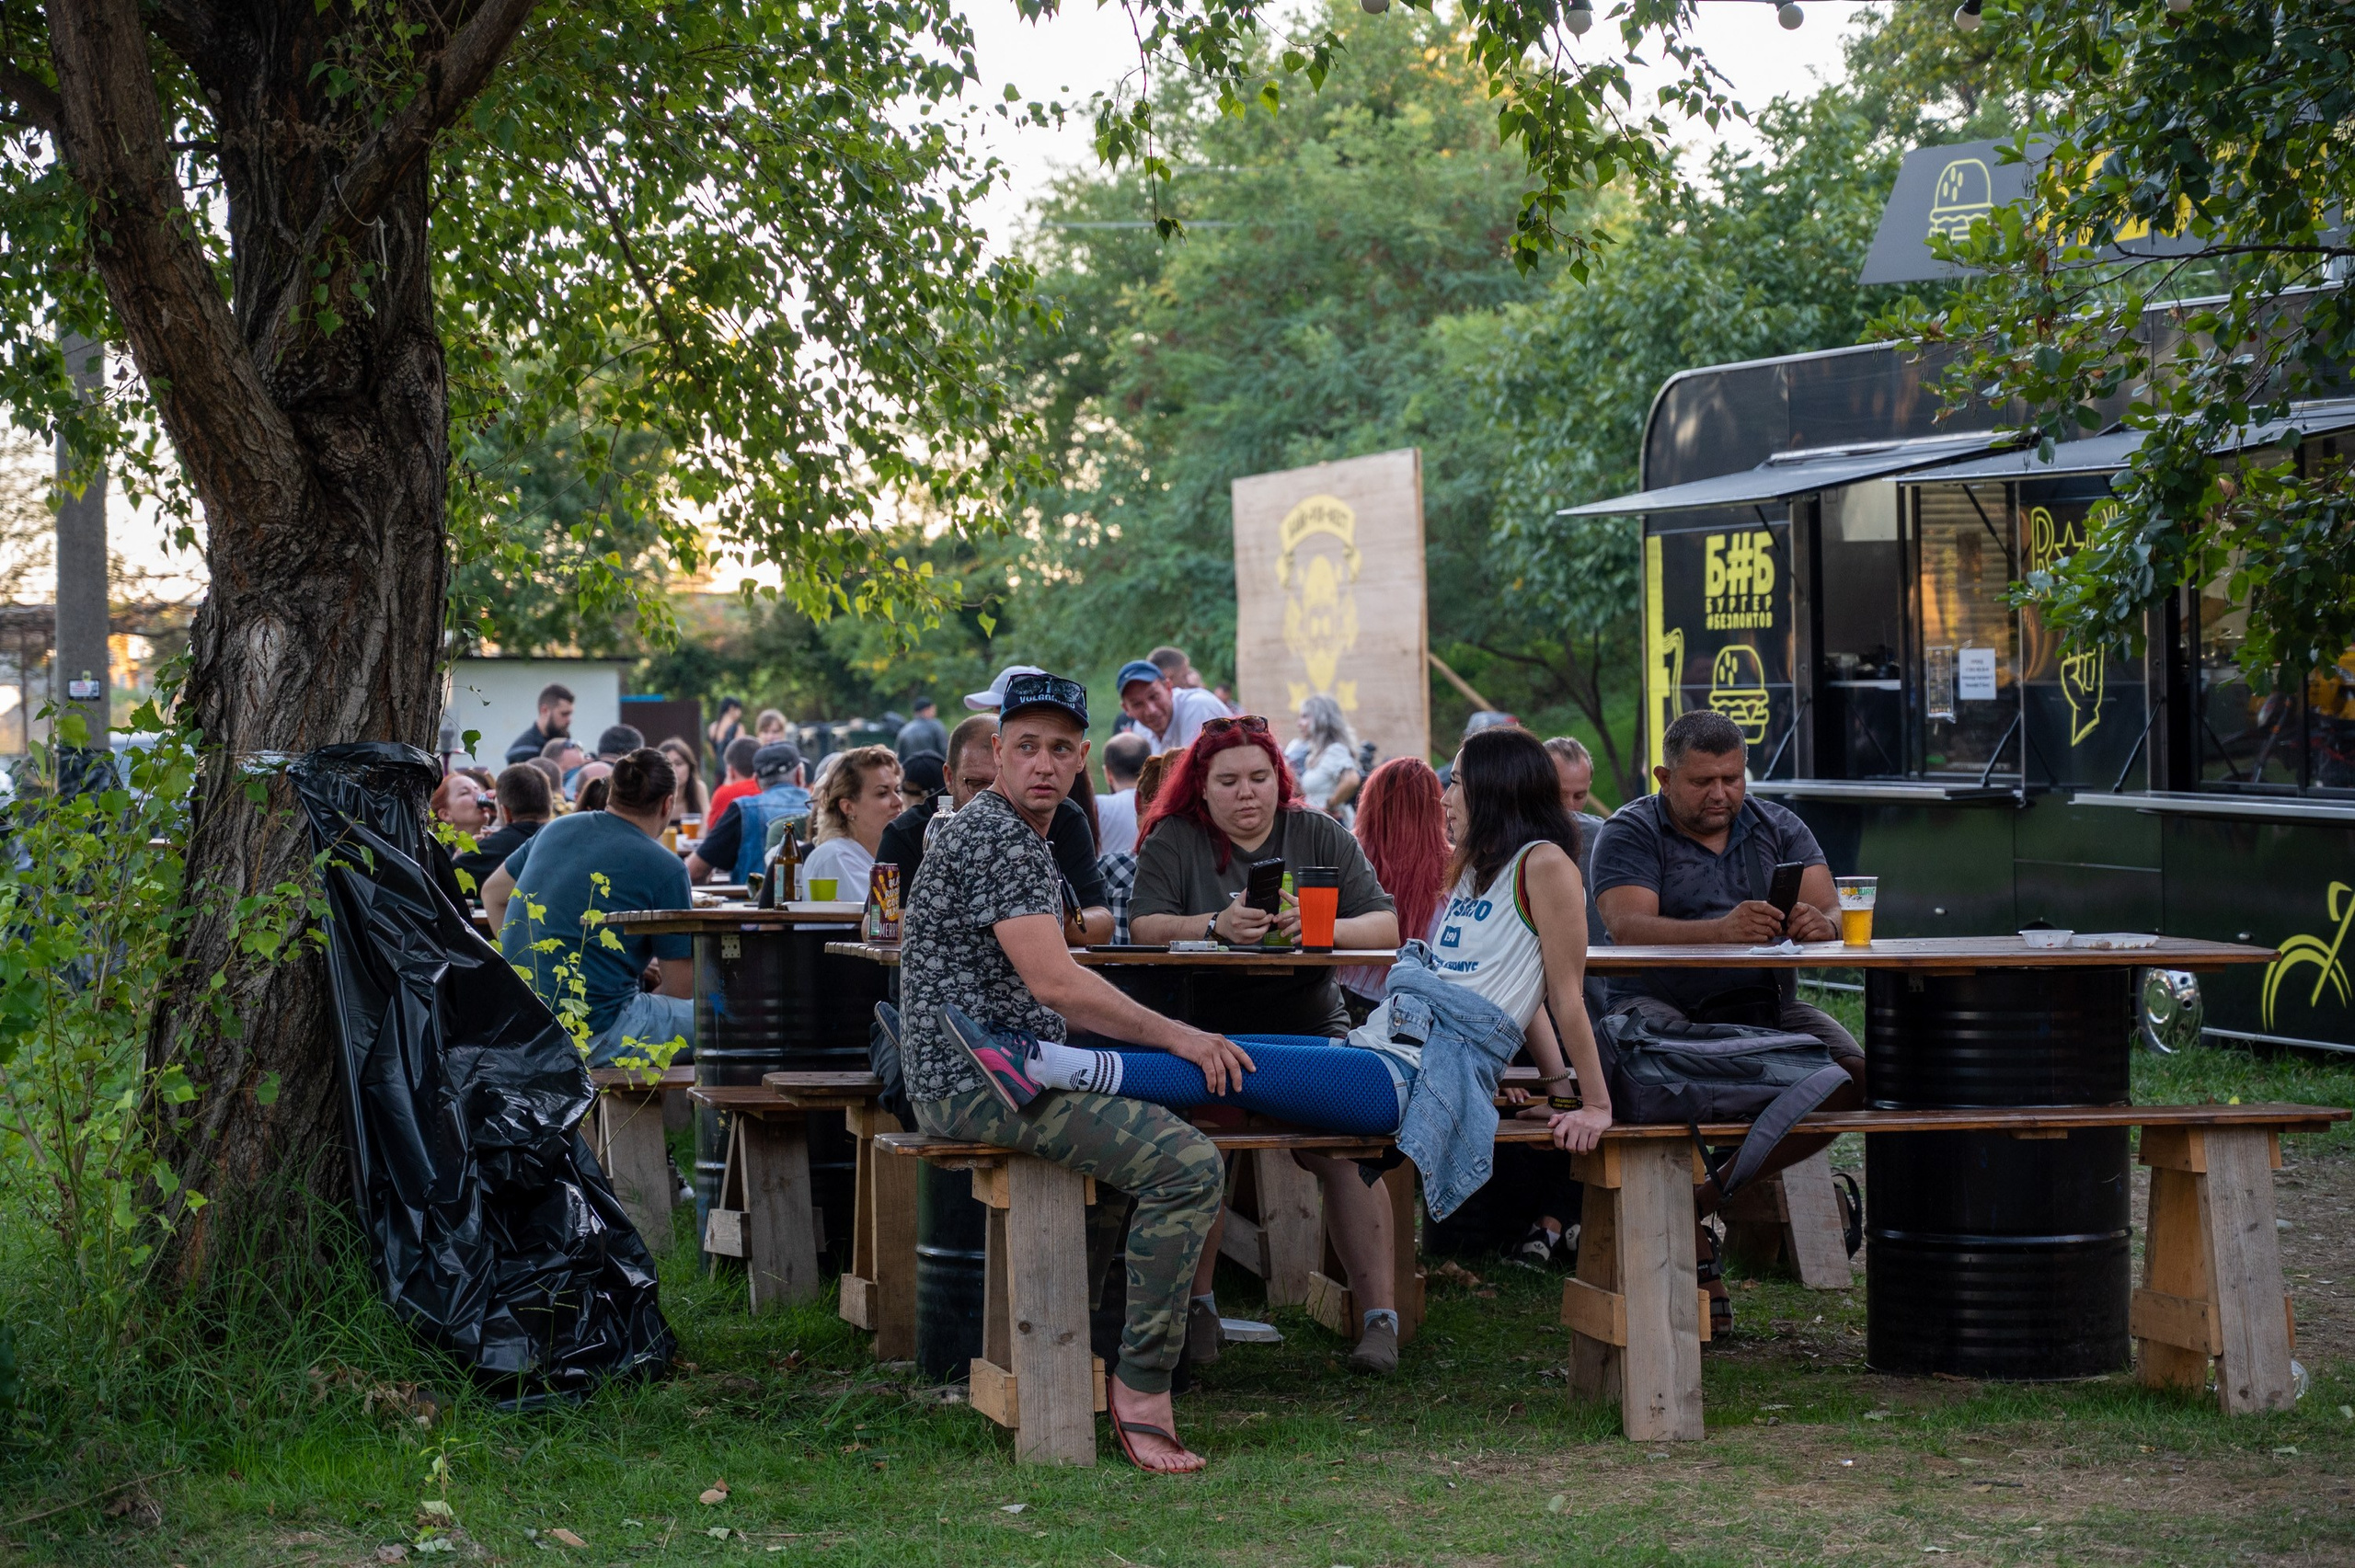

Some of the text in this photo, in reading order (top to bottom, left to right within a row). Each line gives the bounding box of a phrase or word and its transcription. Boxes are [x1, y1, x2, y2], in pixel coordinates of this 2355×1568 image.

[1705, 531, 1775, 598] Б#Б
[1706, 594, 1773, 614] БУРГЕР
[1706, 611, 1773, 631] #БЕЗПОНТОВ
